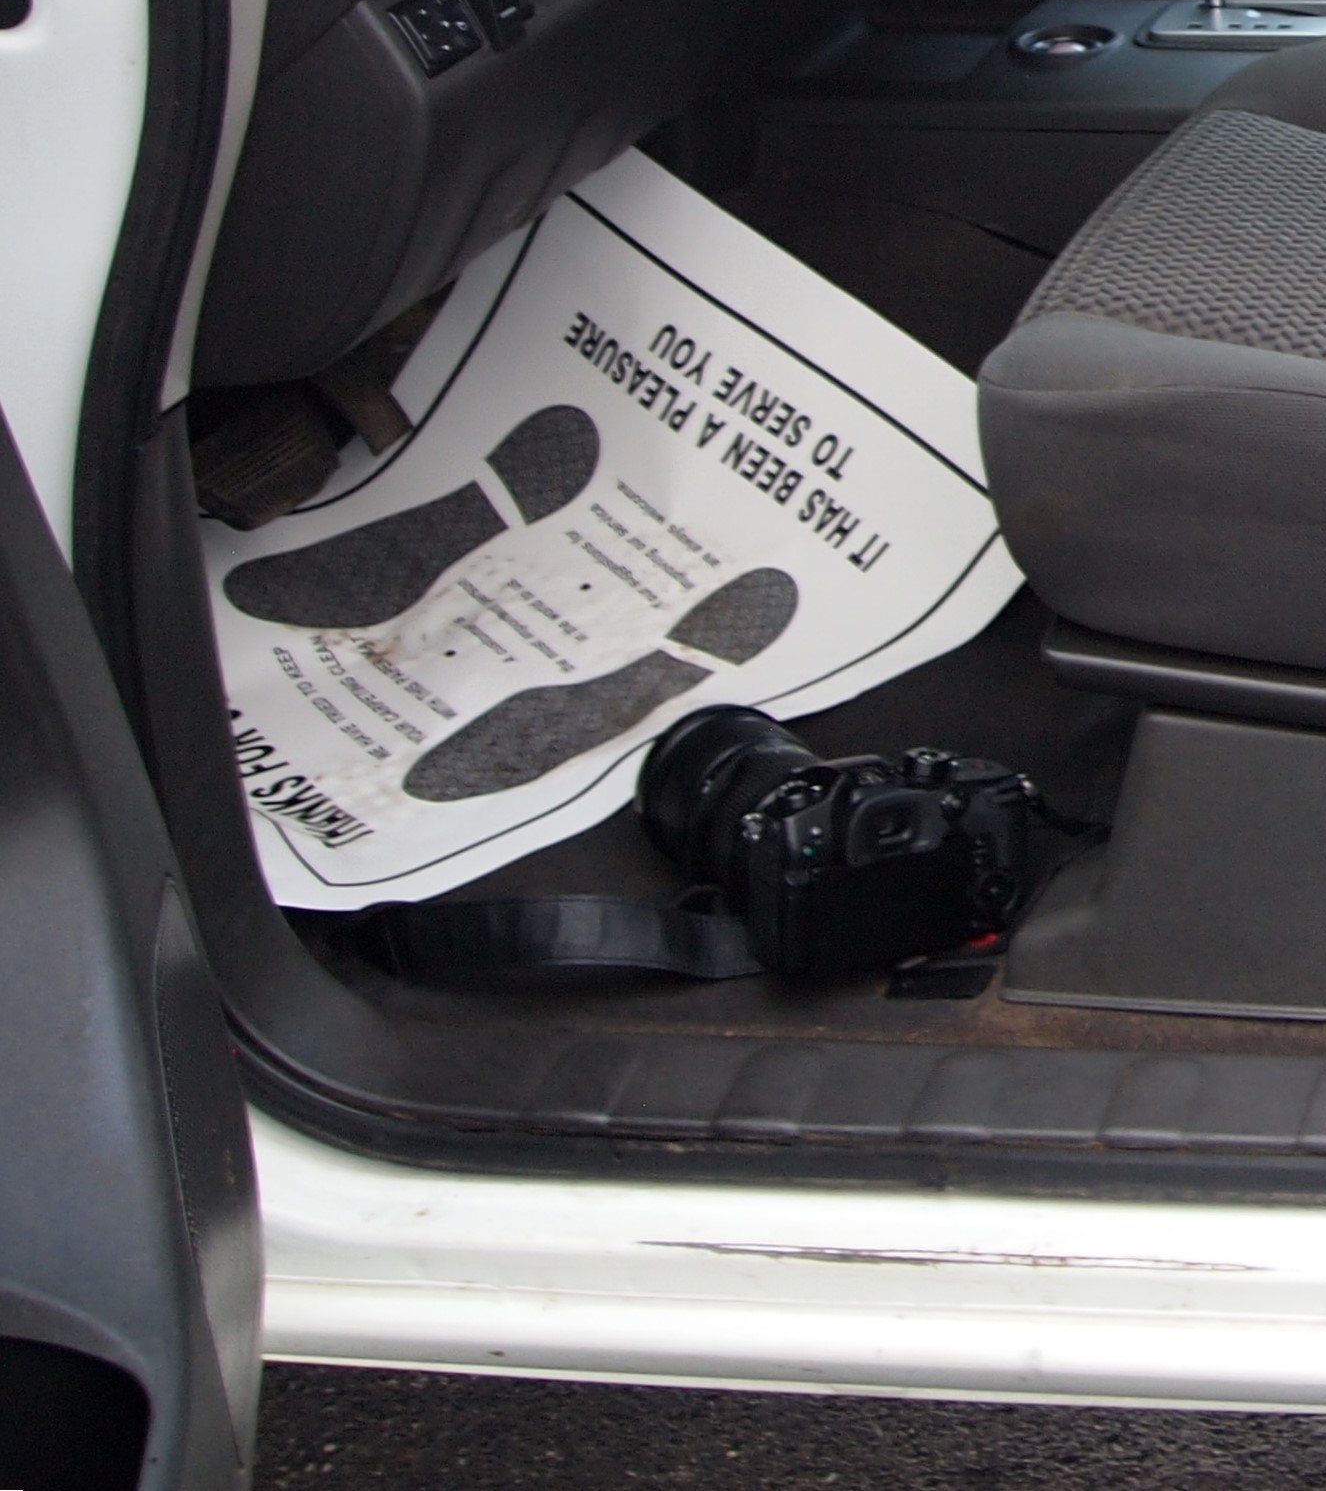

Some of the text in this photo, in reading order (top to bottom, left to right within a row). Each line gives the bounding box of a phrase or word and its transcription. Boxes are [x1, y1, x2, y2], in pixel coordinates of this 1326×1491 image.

[649, 324, 853, 481] TO SERVE YOU
[564, 312, 890, 573] IT HAS BEEN A PLEASURE
[272, 648, 304, 680] KEEP
[310, 635, 346, 676] CLEAN
[250, 775, 374, 848] THANKS
